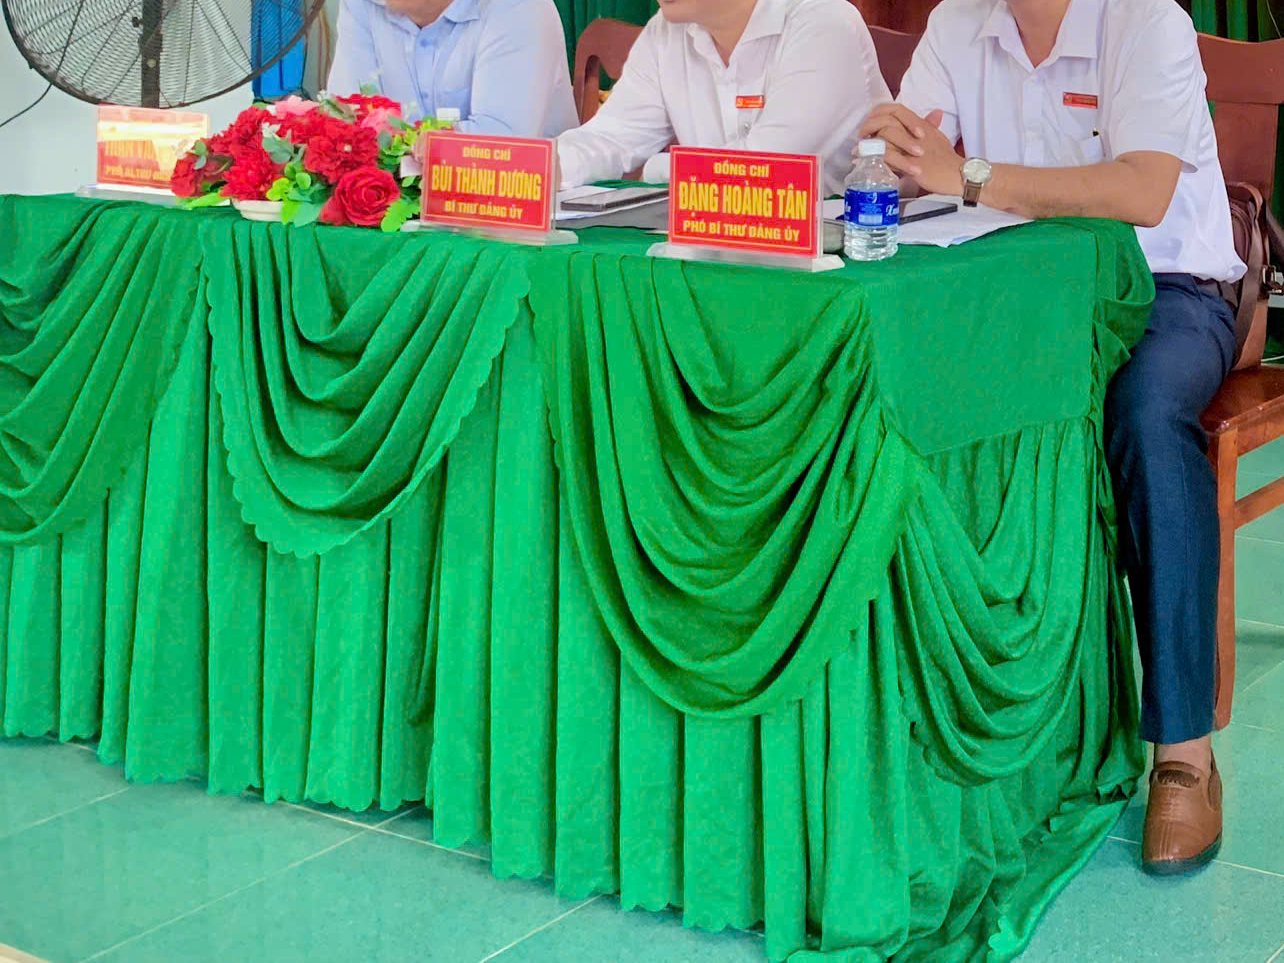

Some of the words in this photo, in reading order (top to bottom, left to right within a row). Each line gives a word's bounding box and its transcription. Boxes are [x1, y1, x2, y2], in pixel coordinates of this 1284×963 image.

[431, 159, 454, 192] BÙI
[455, 161, 496, 197] THÀNH
[498, 168, 542, 201] DƯƠNG
[749, 163, 770, 178] CHÍ
[679, 176, 719, 218] ĐẶNG
[721, 180, 773, 218] HOÀNG
[776, 183, 808, 221] TÂN
[683, 219, 707, 234] PHÓ
[723, 223, 746, 237] THƯ
